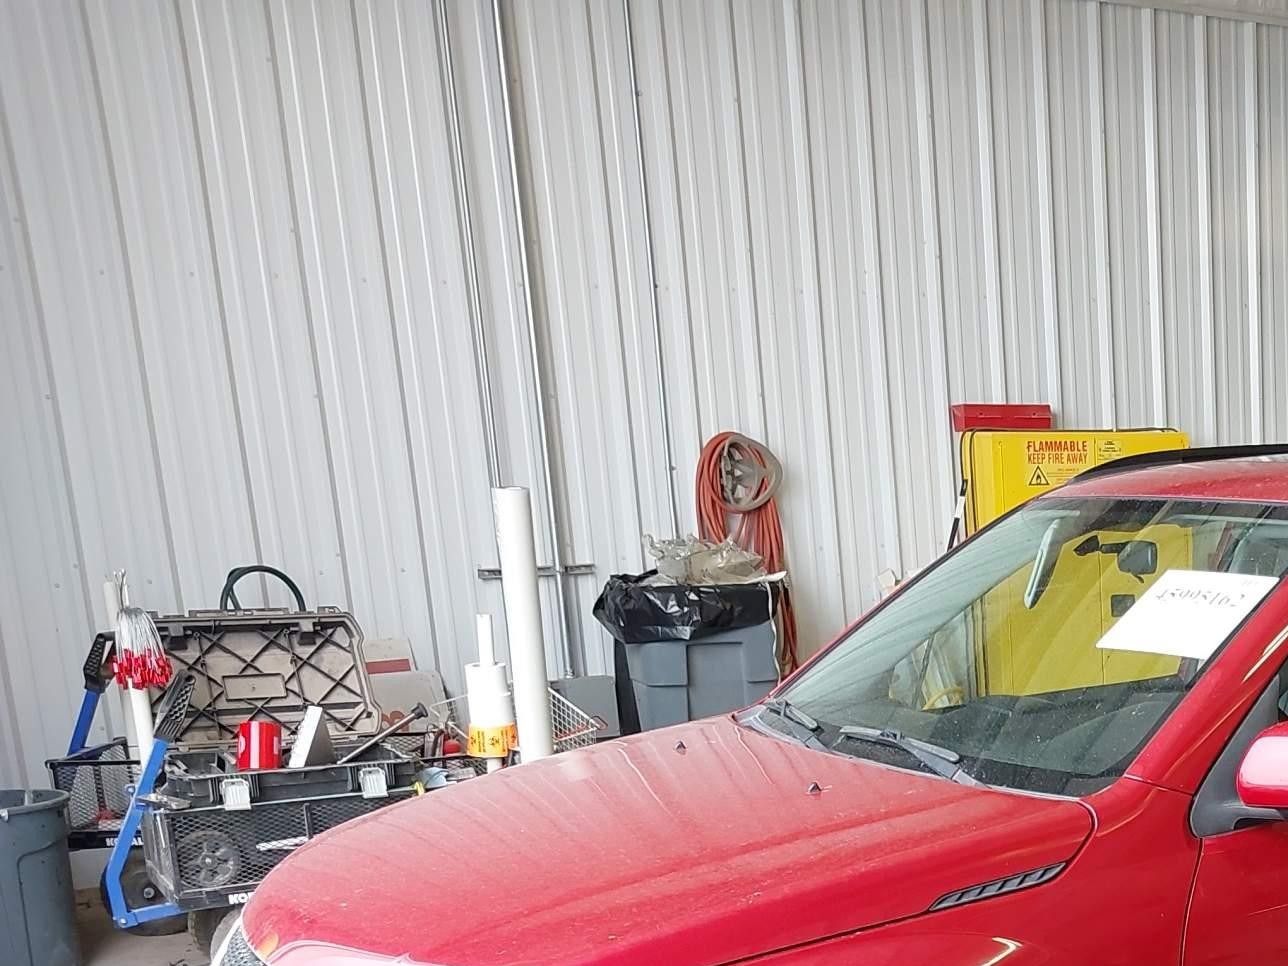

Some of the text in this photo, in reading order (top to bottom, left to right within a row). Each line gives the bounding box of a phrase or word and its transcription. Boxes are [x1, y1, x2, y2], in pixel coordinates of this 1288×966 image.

[1026, 440, 1088, 453] FLAMMABLE
[1027, 452, 1088, 465] KEEP FIRE AWAY
